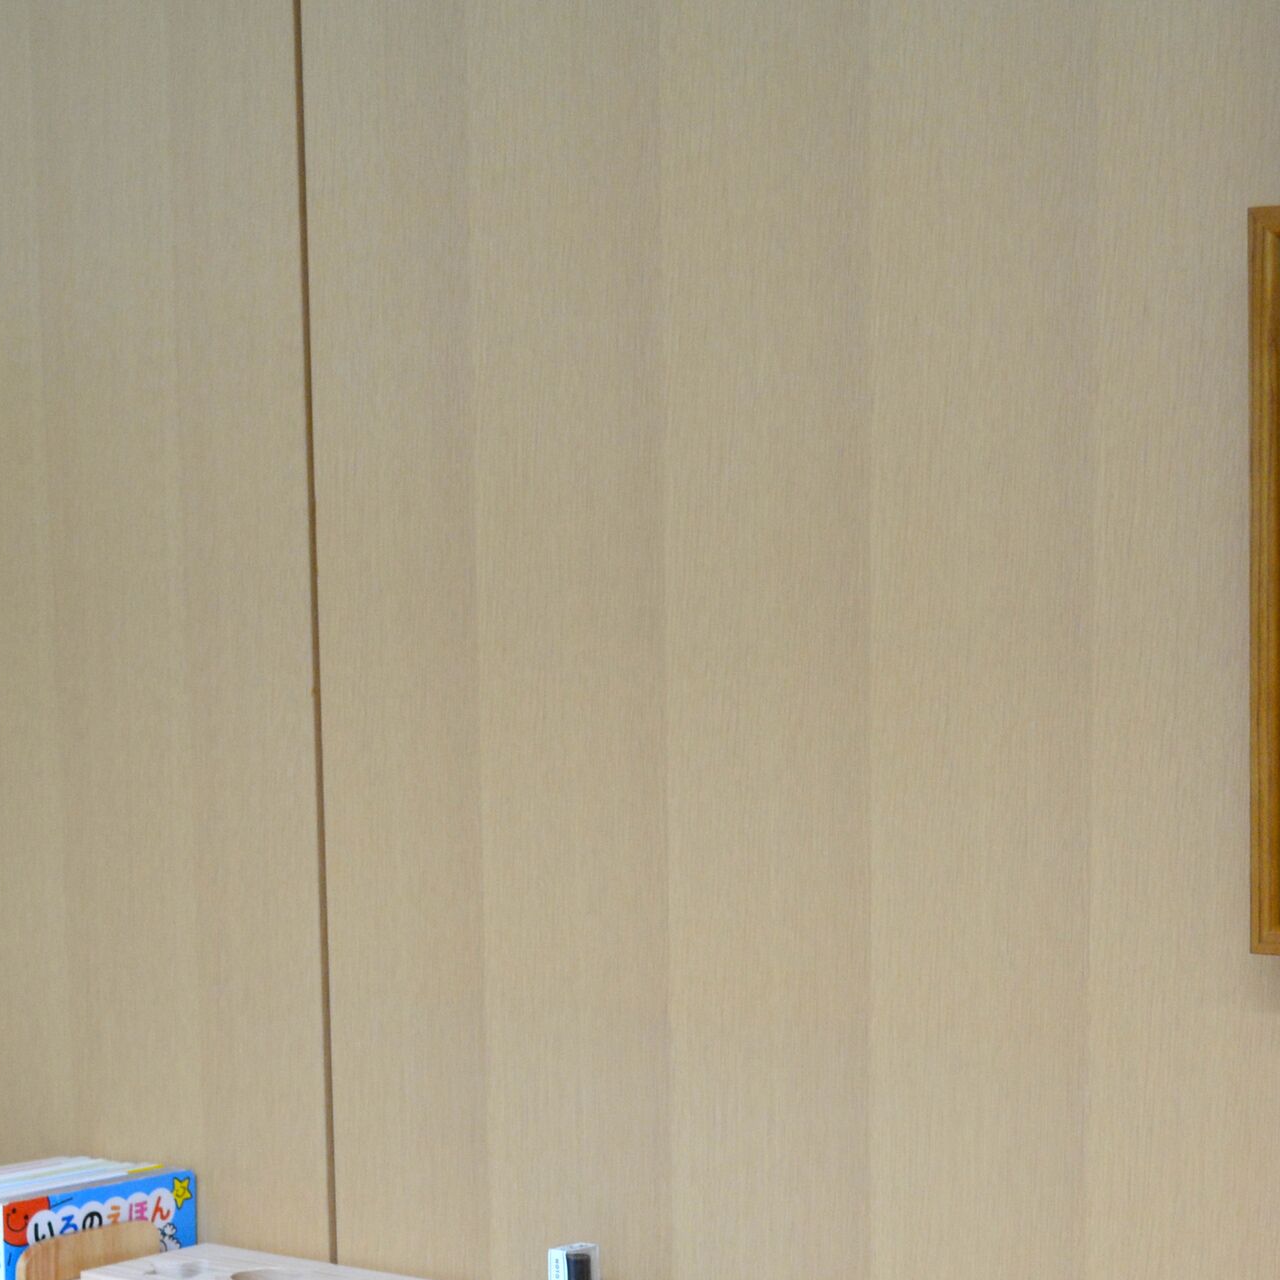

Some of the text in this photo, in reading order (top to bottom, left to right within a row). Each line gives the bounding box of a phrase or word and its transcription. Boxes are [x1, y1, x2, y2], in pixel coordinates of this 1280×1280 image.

[34, 1196, 170, 1242] いろのえほん
